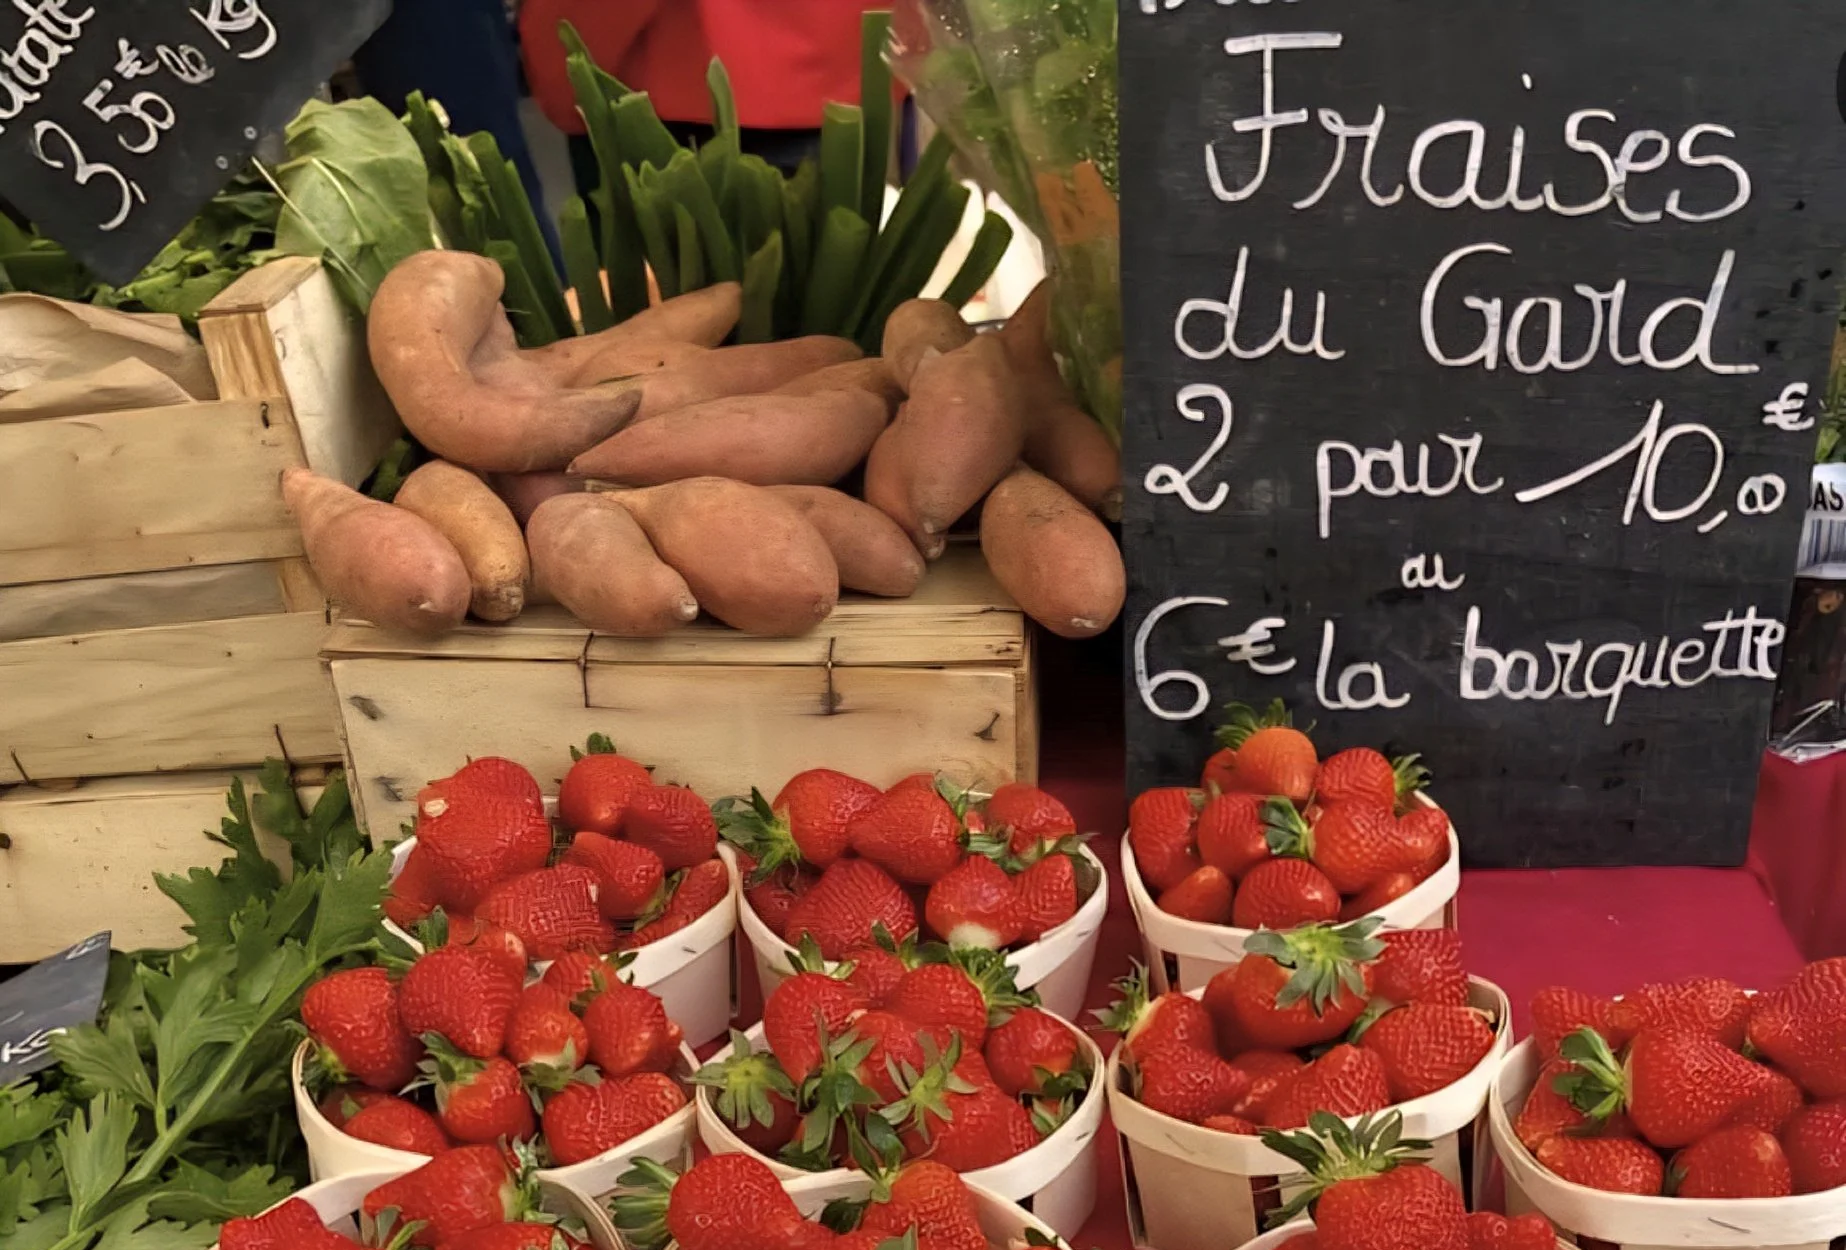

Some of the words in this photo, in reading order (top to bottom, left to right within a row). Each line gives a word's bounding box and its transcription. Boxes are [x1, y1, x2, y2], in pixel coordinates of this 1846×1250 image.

[0, 0, 95, 134] atate
[1205, 32, 1751, 223] Fraises
[1174, 246, 1345, 360] du
[1420, 242, 1760, 374] Gard
[1144, 383, 1233, 511] 2
[1316, 432, 1504, 539] pour
[1315, 619, 1410, 710] la
[1458, 605, 1786, 725] barquette
